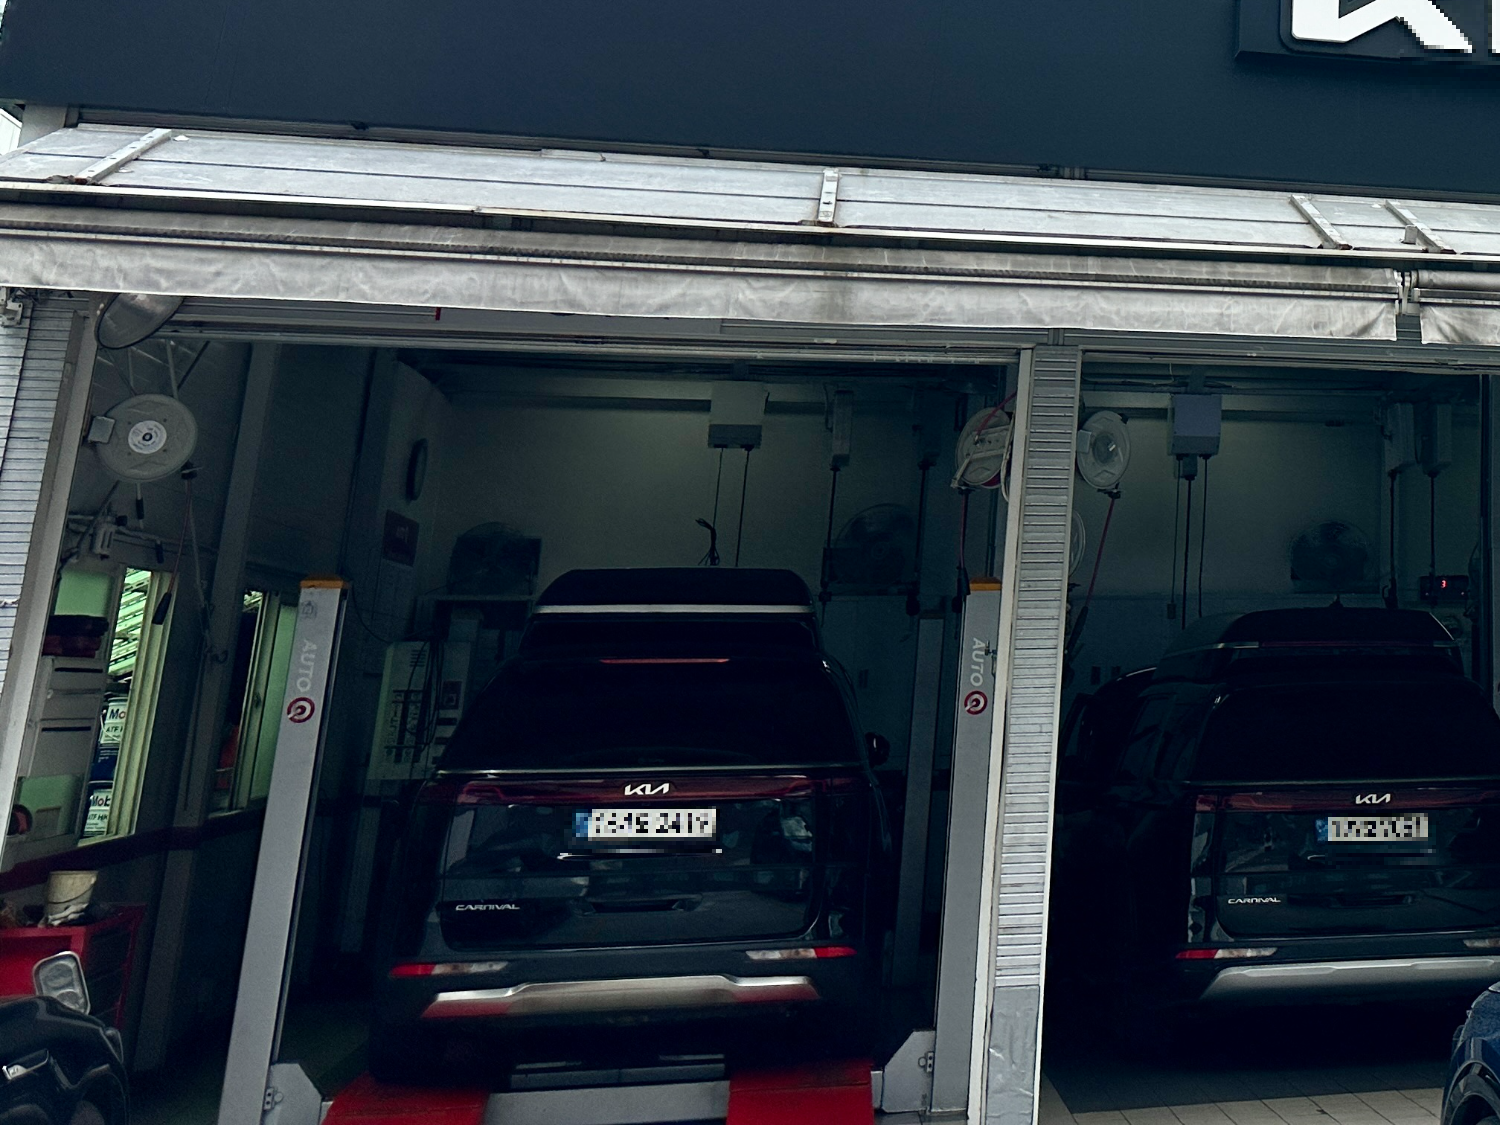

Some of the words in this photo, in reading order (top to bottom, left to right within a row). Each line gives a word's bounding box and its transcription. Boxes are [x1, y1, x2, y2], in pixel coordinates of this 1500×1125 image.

[296, 638, 318, 693] AUTO
[969, 637, 988, 687] AUTO
[624, 782, 670, 796] KIA
[1355, 793, 1391, 805] KIA
[455, 903, 521, 911] CARNIVAL
